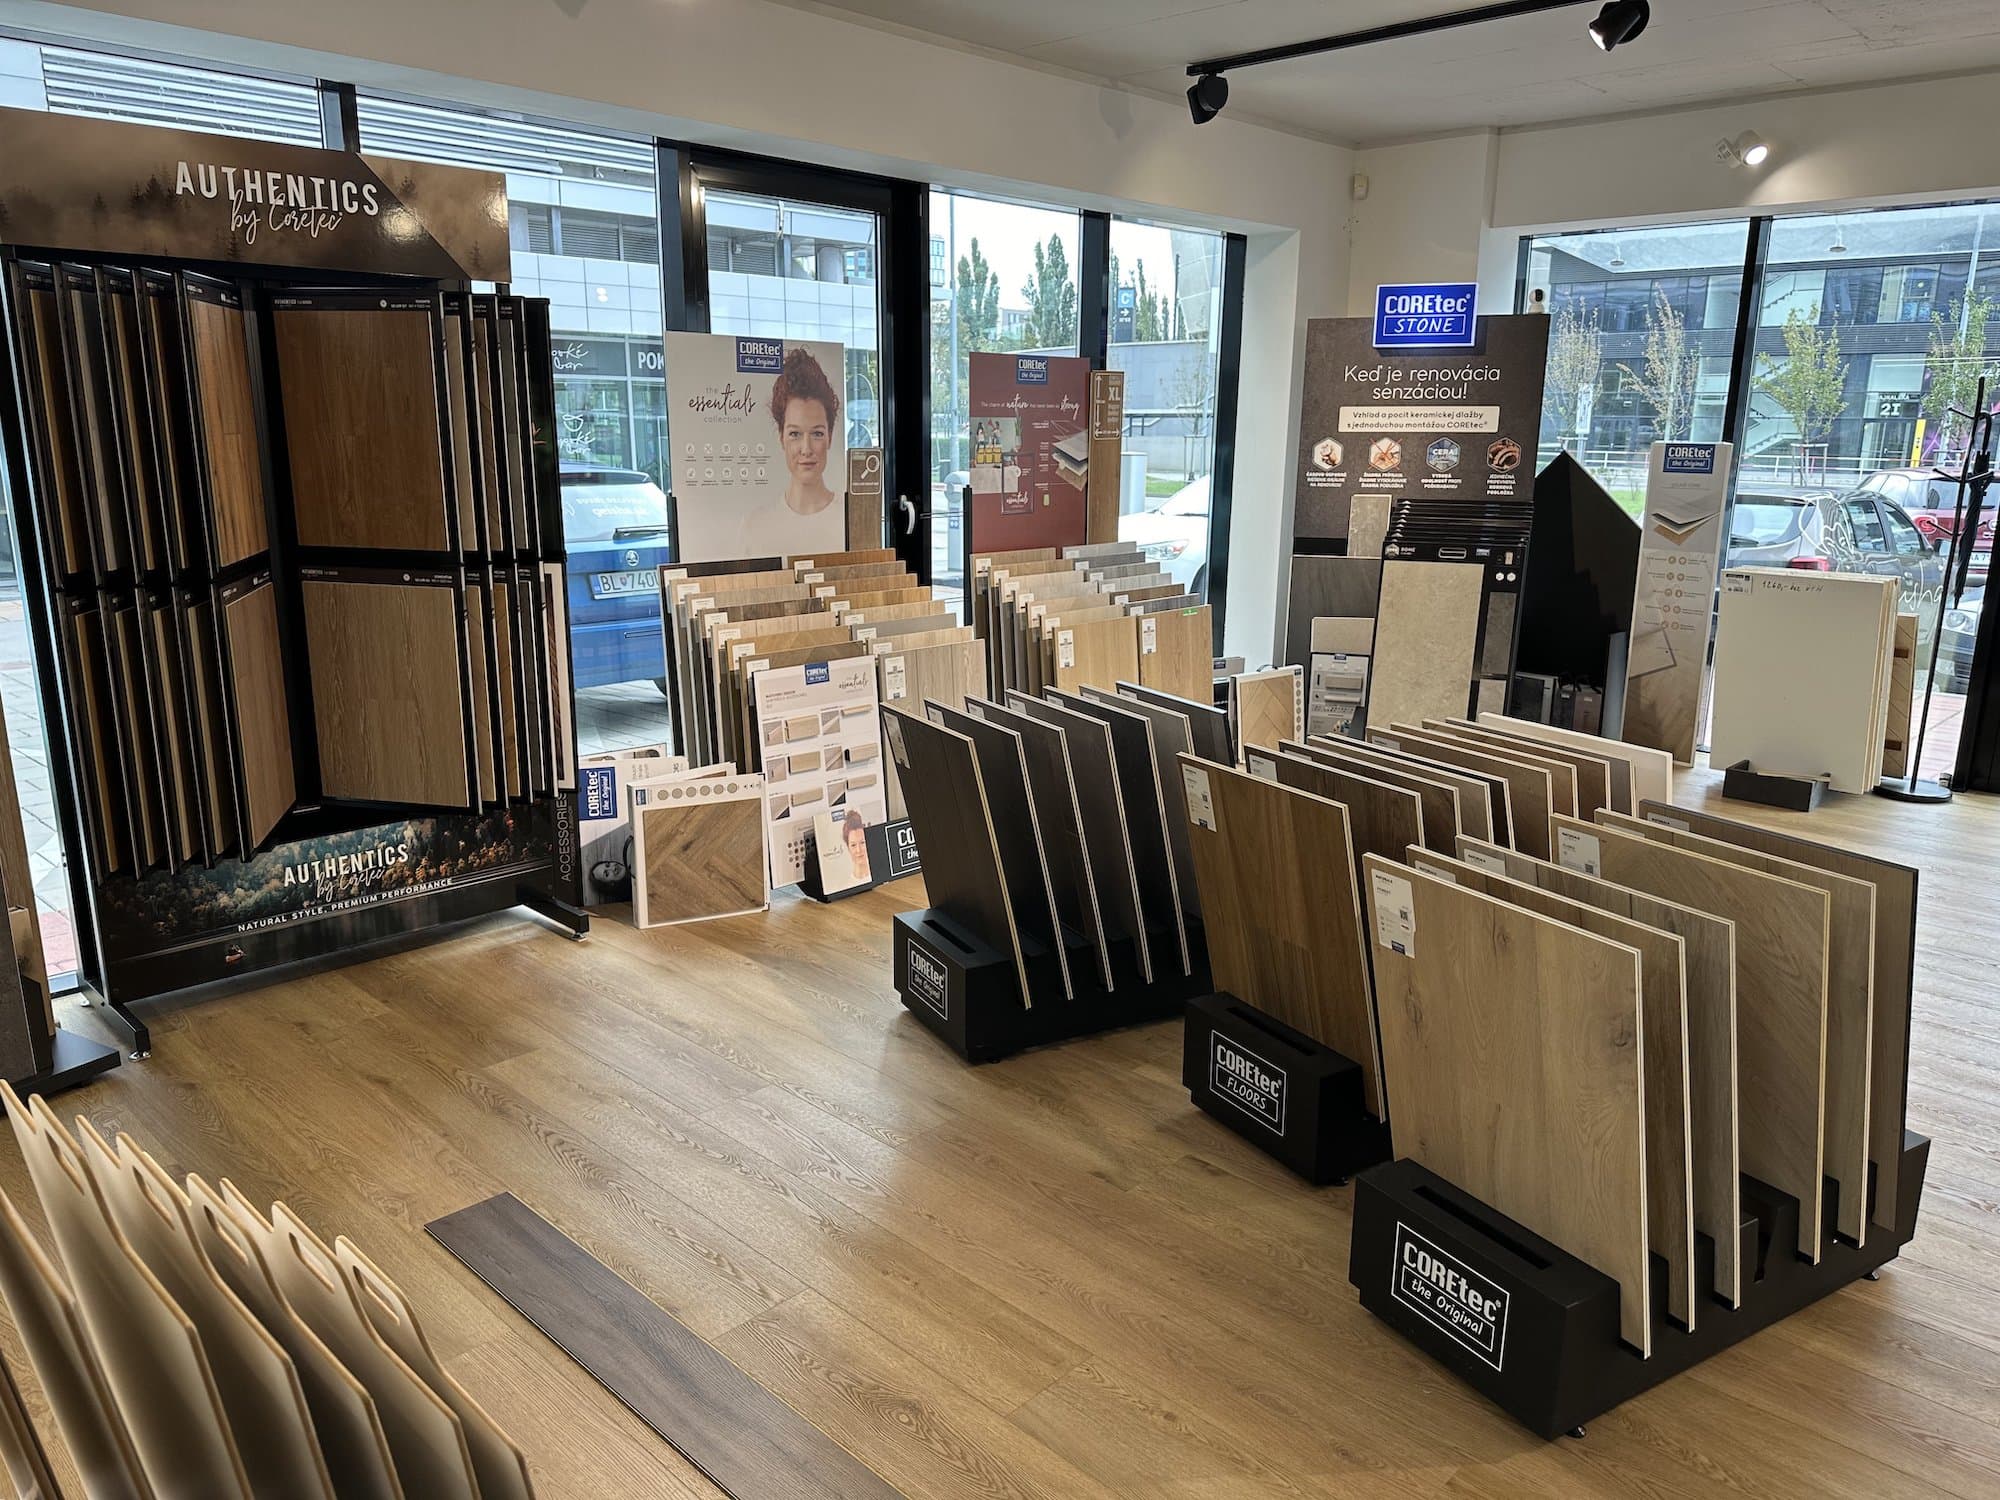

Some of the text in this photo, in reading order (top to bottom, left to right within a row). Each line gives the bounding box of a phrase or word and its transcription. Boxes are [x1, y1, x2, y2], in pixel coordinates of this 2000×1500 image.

[175, 161, 379, 216] AUTHENTICS
[231, 189, 343, 244] by Coretec
[1393, 317, 1454, 333] STONE
[739, 342, 780, 355] COREtec
[553, 356, 583, 371] bar
[1344, 365, 1501, 386] Keď je renovácia
[688, 383, 756, 416] essentials
[1108, 387, 1120, 401] XL
[1372, 383, 1468, 400] senzáciou!
[1352, 421, 1404, 430] jednoduchou
[1405, 421, 1446, 429] montážou
[1411, 411, 1454, 420] keramickej
[1456, 410, 1484, 419] dlažby
[1668, 447, 1712, 458] COREtec
[601, 575, 621, 592] BL
[587, 770, 600, 816] COREtec
[284, 844, 409, 887] AUTHENTICS
[316, 871, 334, 902] by
[237, 915, 287, 932] NATURAL
[331, 894, 378, 911] PREMIUM
[381, 878, 453, 899] PERFORMANCE
[1217, 1044, 1280, 1098] COREtec
[1227, 1076, 1267, 1110] FLOORS
[1411, 1278, 1484, 1335] the Original
